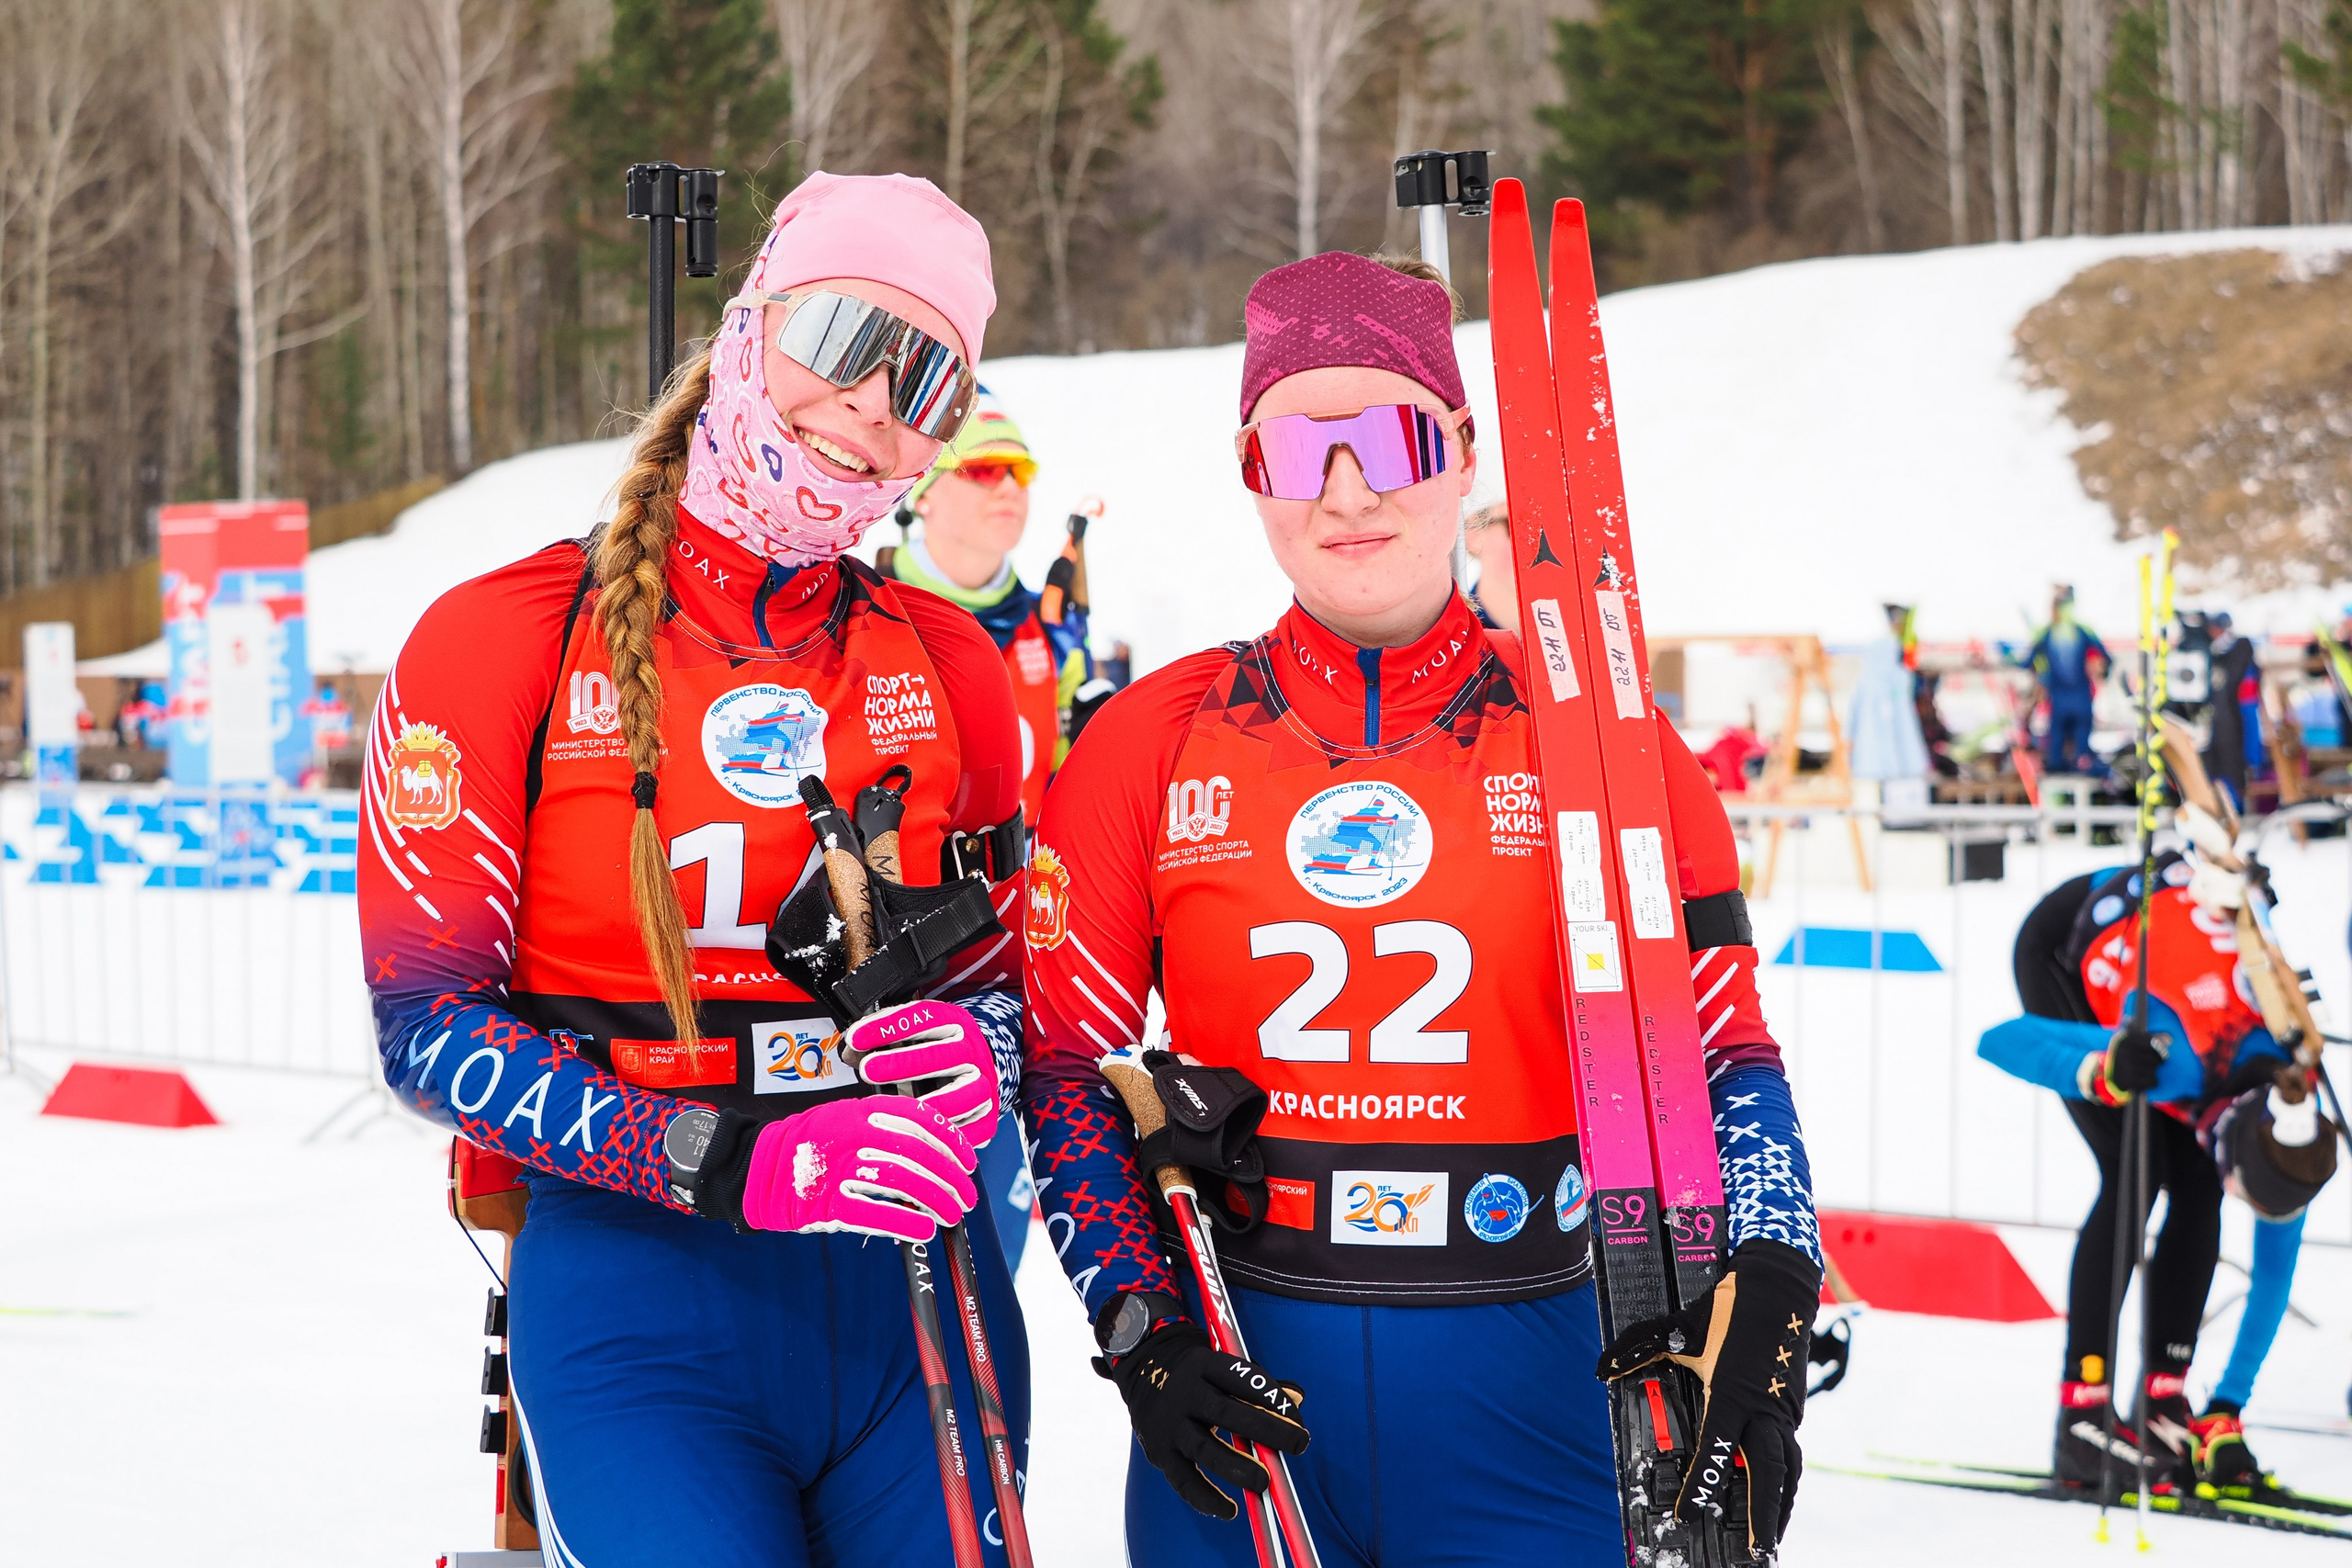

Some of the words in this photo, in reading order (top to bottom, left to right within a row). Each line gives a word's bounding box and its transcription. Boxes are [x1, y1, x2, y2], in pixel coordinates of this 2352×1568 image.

[679, 541, 730, 590] OAX
[866, 671, 911, 695] СПОРТ
[710, 687, 777, 717] ПЕРВЕНСТВО
[778, 690, 822, 716] РОССИИ
[864, 689, 933, 716] НОРМА
[865, 709, 936, 736] ЖИЗНИ
[551, 738, 626, 750] МИНИСТЕРСТВО
[871, 729, 938, 746] ФЕДЕРАЛЬНЫЙ
[875, 744, 910, 756] ПРОЕКТ
[547, 748, 606, 761] РОССИЙСКОЙ
[732, 781, 794, 803] Красноярск
[1216, 791, 1235, 800] ЛЕТ
[1300, 784, 1374, 818] ПЕРВЕНСТВО
[1375, 784, 1419, 817] РОССИИ
[1486, 792, 1542, 814] НОРМ
[1488, 813, 1544, 835] ЖИЗН
[1158, 855, 1198, 873] РОССИЙСКОЙ
[1199, 850, 1252, 863] ФЕДЕРАЦИИ
[1159, 843, 1215, 862] МИНИСТЕРСТВО
[1216, 840, 1250, 851] СПОРТА
[1492, 846, 1532, 857] ПРОЕКТ
[670, 820, 818, 950] 1
[1312, 882, 1377, 902] Красноярск
[1381, 877, 1408, 897] 2023
[1574, 924, 1595, 933] YOUR
[1248, 919, 1474, 1065] 22
[879, 1009, 934, 1039] MOAX
[649, 1043, 729, 1055] КРАСНОРСКИЙ
[649, 1055, 675, 1064] КРАЙ
[767, 1032, 823, 1080] 20
[1576, 998, 1600, 1108] REDSTER
[1645, 1015, 1668, 1124] REDSTER
[404, 1026, 617, 1153] MOAX
[1269, 1089, 1467, 1120] КРАСНОЯРСК
[1266, 1181, 1307, 1195] СНОЯРСКИЙ
[1464, 1179, 1486, 1214] АКАДЕМИЯ
[1507, 1177, 1529, 1208] БИАТЛОНА
[1343, 1181, 1408, 1233] 20
[1601, 1194, 1646, 1225] S9
[1607, 1235, 1648, 1246] CARBON
[1671, 1213, 1715, 1243] S9
[911, 1243, 935, 1294] OAX
[965, 1295, 976, 1312] M2
[967, 1312, 981, 1342] TEAM
[975, 1342, 987, 1363] PRO
[1229, 1360, 1293, 1416] MOAX
[945, 1408, 956, 1424] M2
[947, 1425, 962, 1456] TEAM
[994, 1439, 1003, 1452] HM
[955, 1456, 966, 1477] PRO
[997, 1452, 1010, 1485] CARBON
[1691, 1436, 1732, 1507] MOAX
